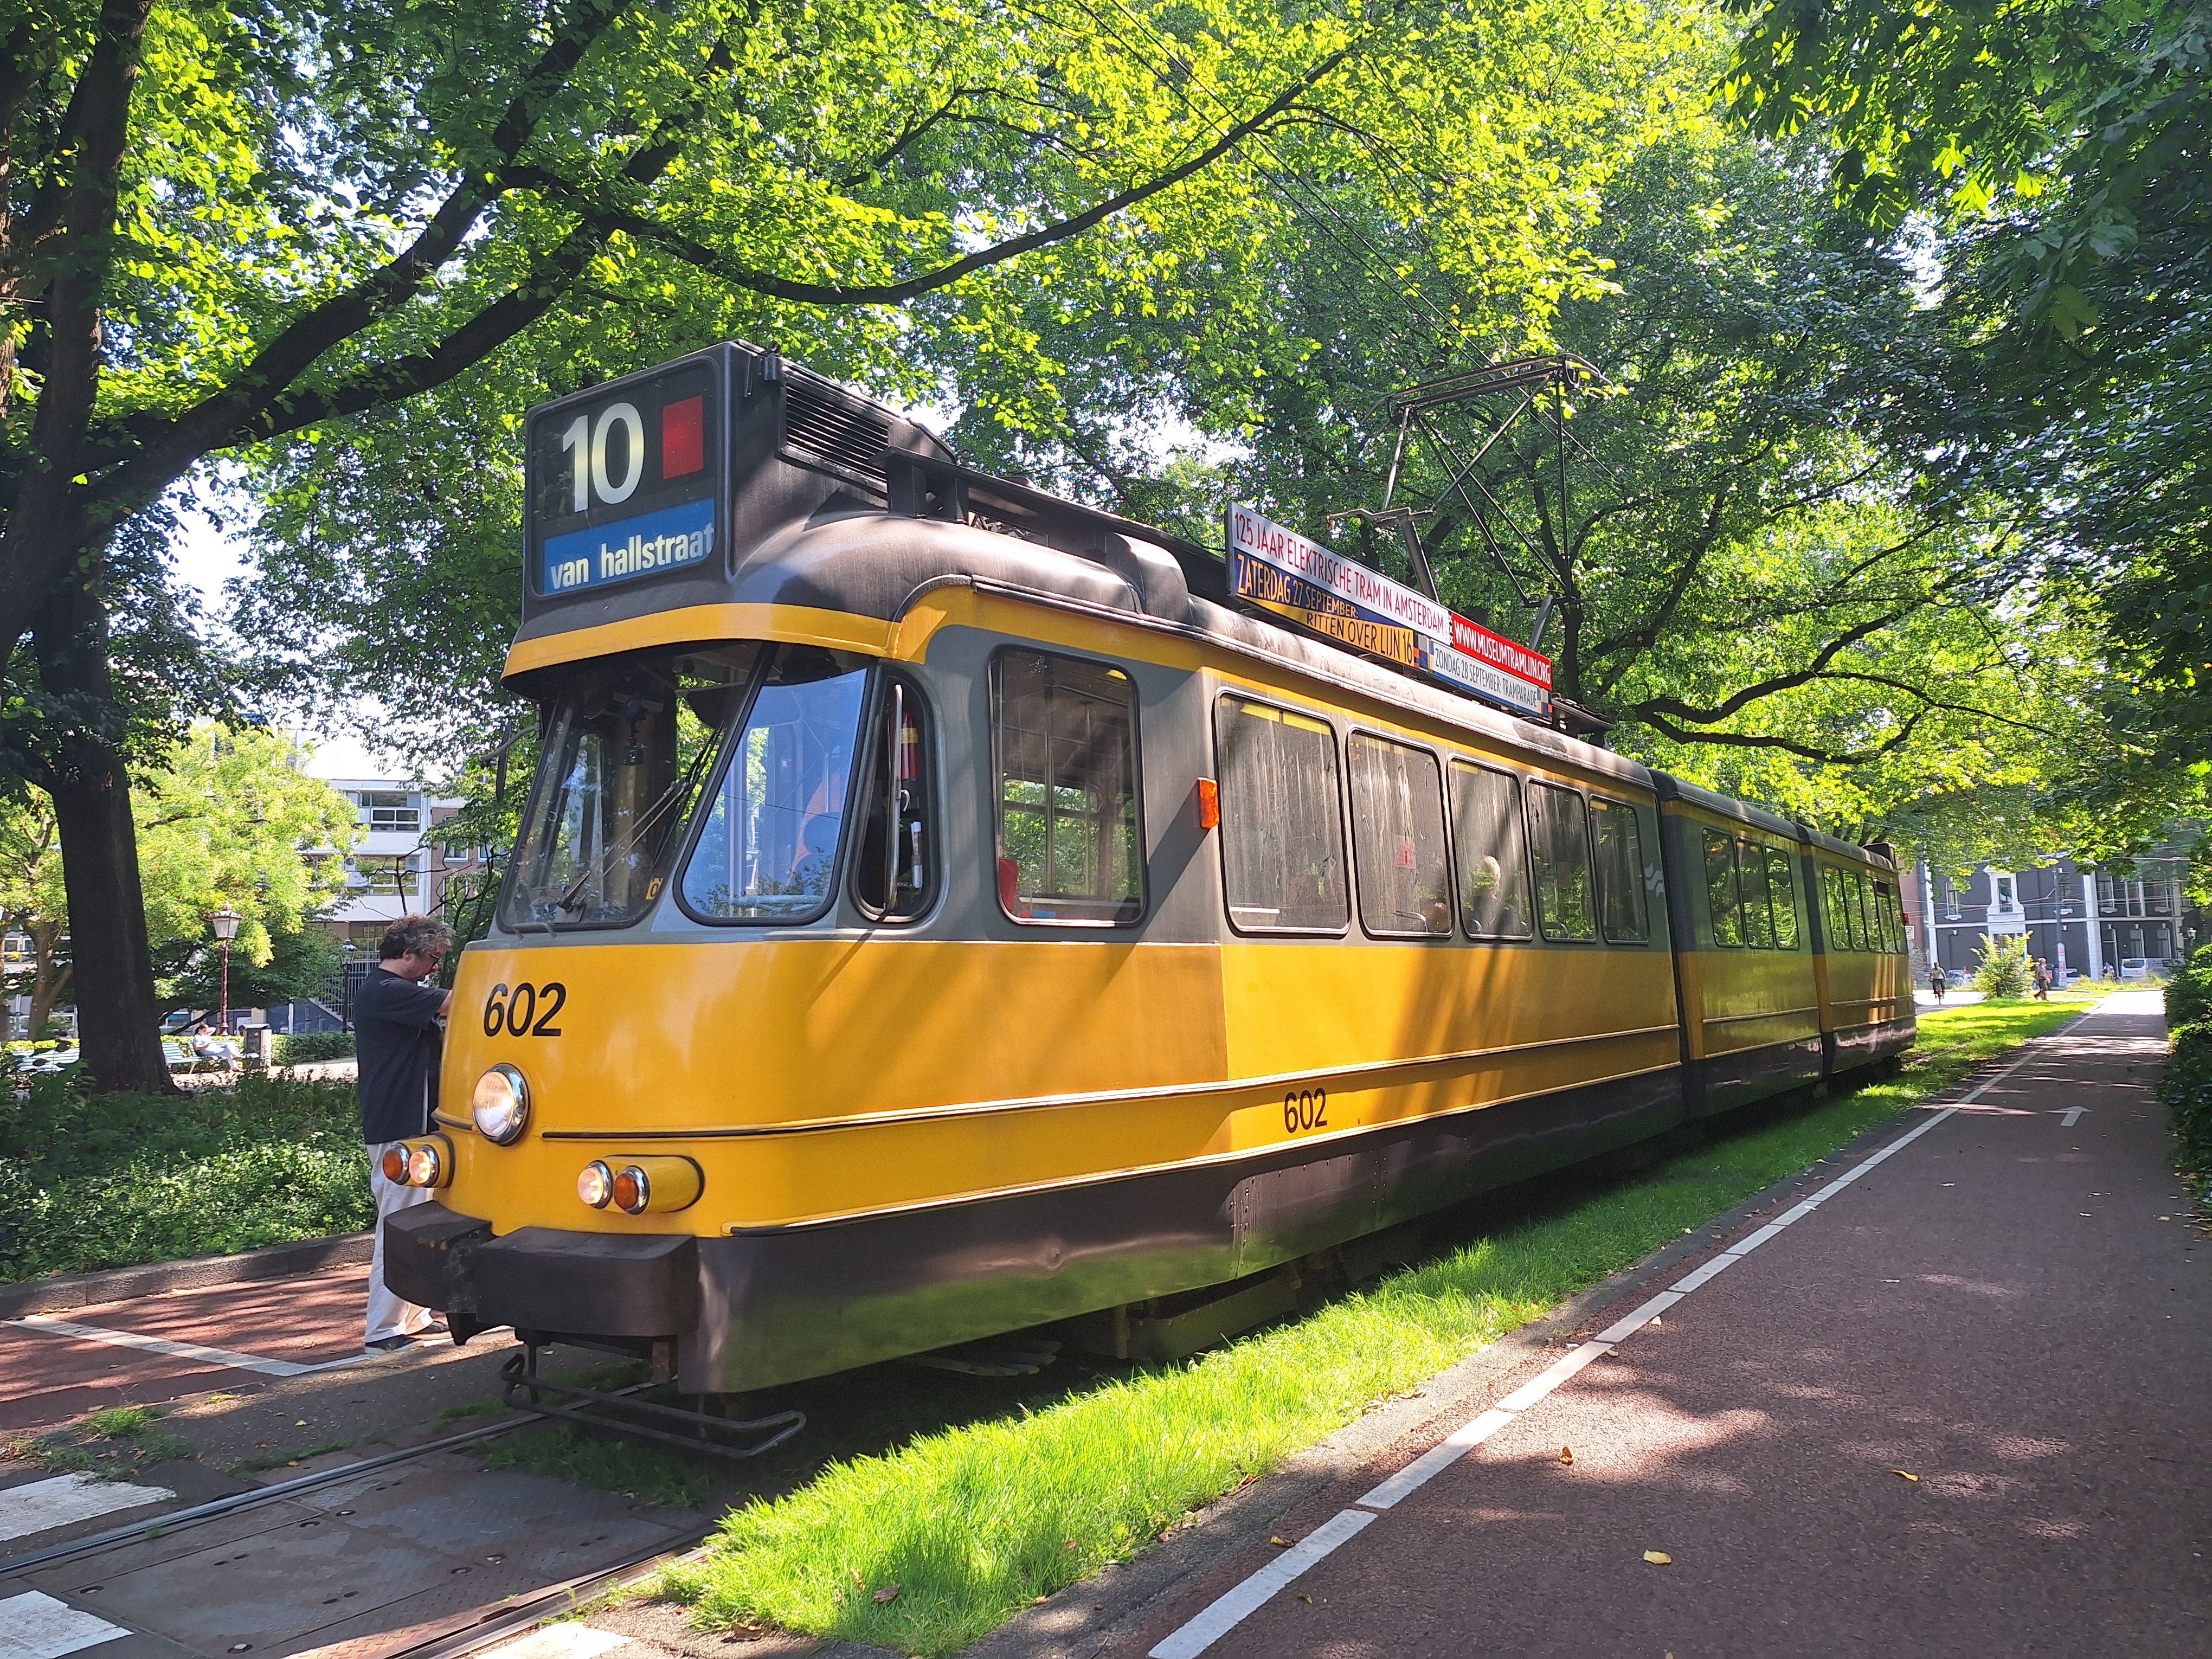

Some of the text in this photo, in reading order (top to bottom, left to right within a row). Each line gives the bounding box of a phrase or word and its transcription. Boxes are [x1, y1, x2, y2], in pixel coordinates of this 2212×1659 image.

[563, 402, 644, 513] 10
[550, 522, 715, 590] van hallstraat
[1234, 512, 1253, 546] 125
[1257, 523, 1285, 562] JAAR
[1287, 537, 1352, 594] ELEKTRISCHE
[1354, 571, 1381, 607] TRAM
[1383, 585, 1392, 612] IN
[1394, 591, 1444, 636] AMSTERDAM
[1237, 554, 1359, 619] ZATERDAG 27 SEPTEMBER:
[1307, 612, 1413, 664] RITTEN OVER LIJN 16
[1454, 620, 1551, 685] WWW.MUSEUMTRAMLIJN.ORG
[1435, 648, 1537, 708] ZONDAG 28 SEPTEMBER: TRAMPARADE
[484, 982, 567, 1037] 602
[1284, 1087, 1328, 1133] 602
